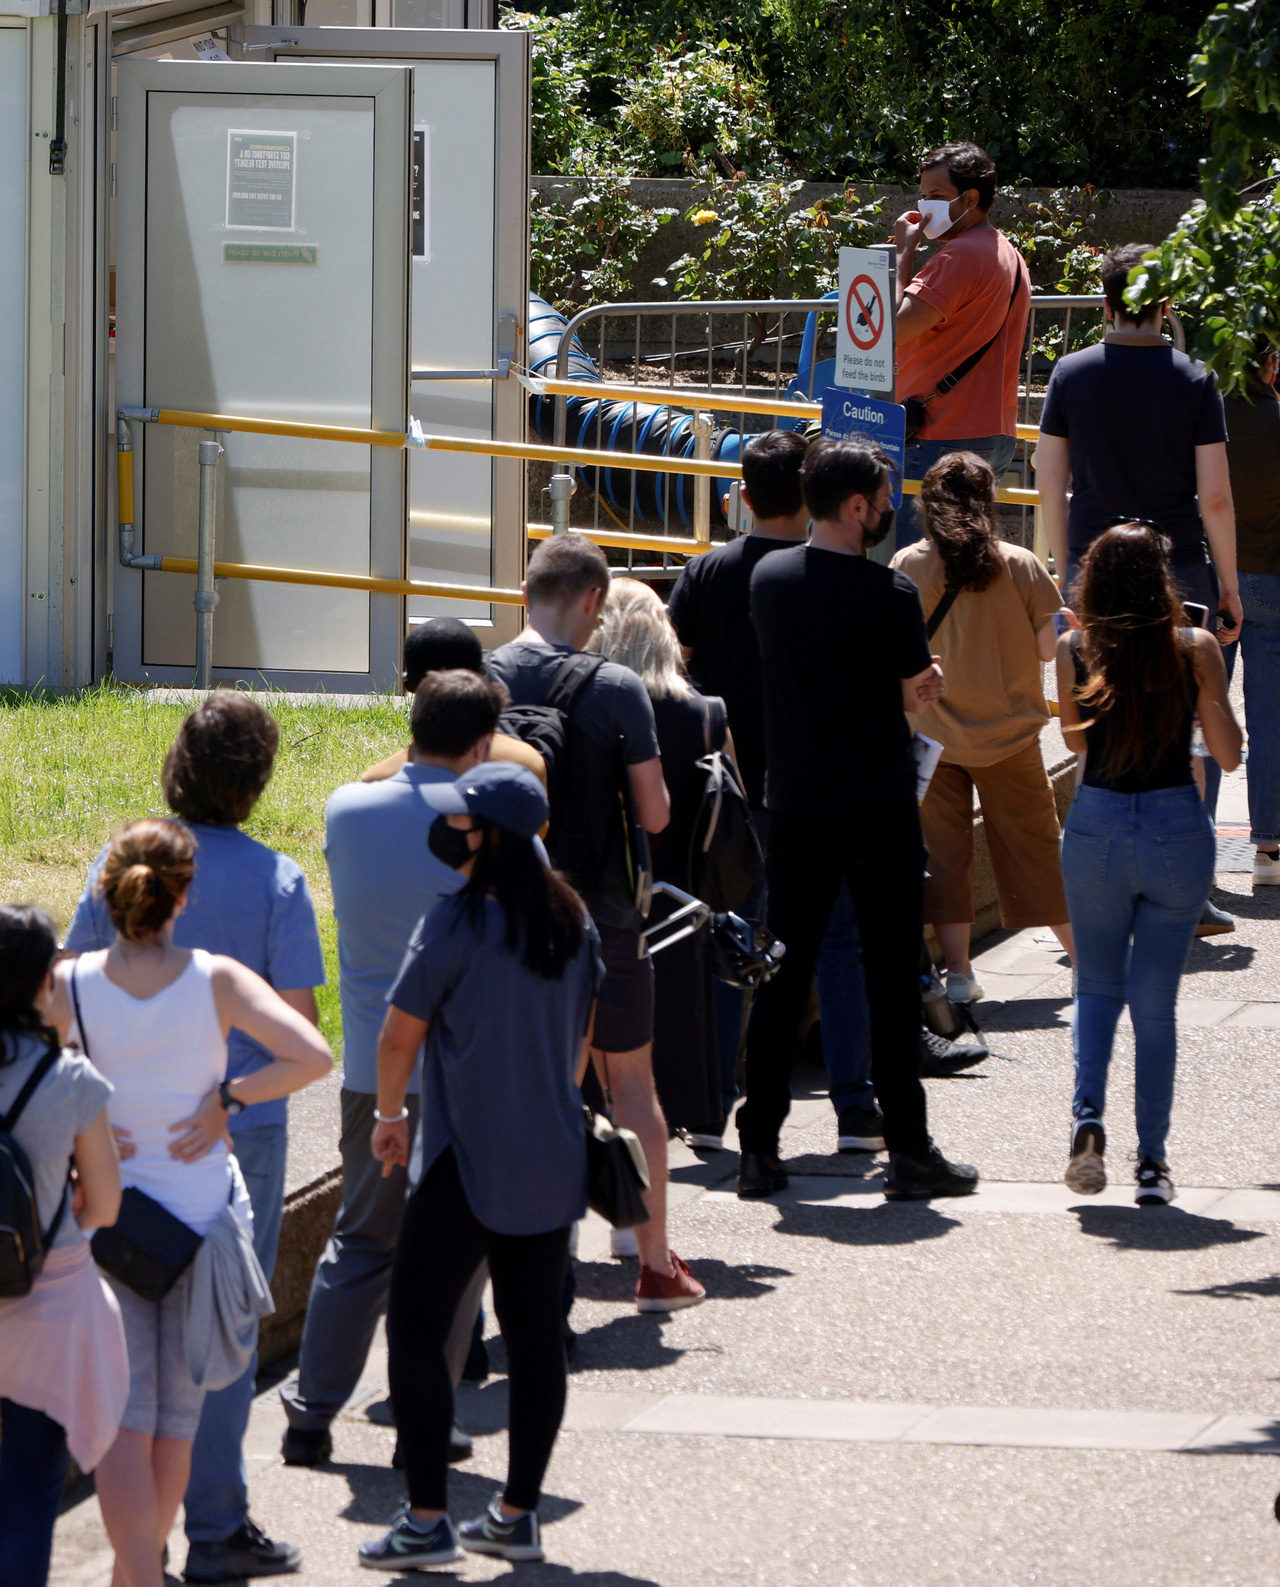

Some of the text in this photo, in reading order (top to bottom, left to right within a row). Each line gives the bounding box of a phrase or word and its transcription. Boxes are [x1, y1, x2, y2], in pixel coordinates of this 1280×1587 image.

[843, 354, 886, 369] Please do not
[842, 367, 886, 383] feed the birds
[843, 401, 884, 425] Caution
[825, 428, 842, 439] Please
[880, 441, 901, 453] fountain
